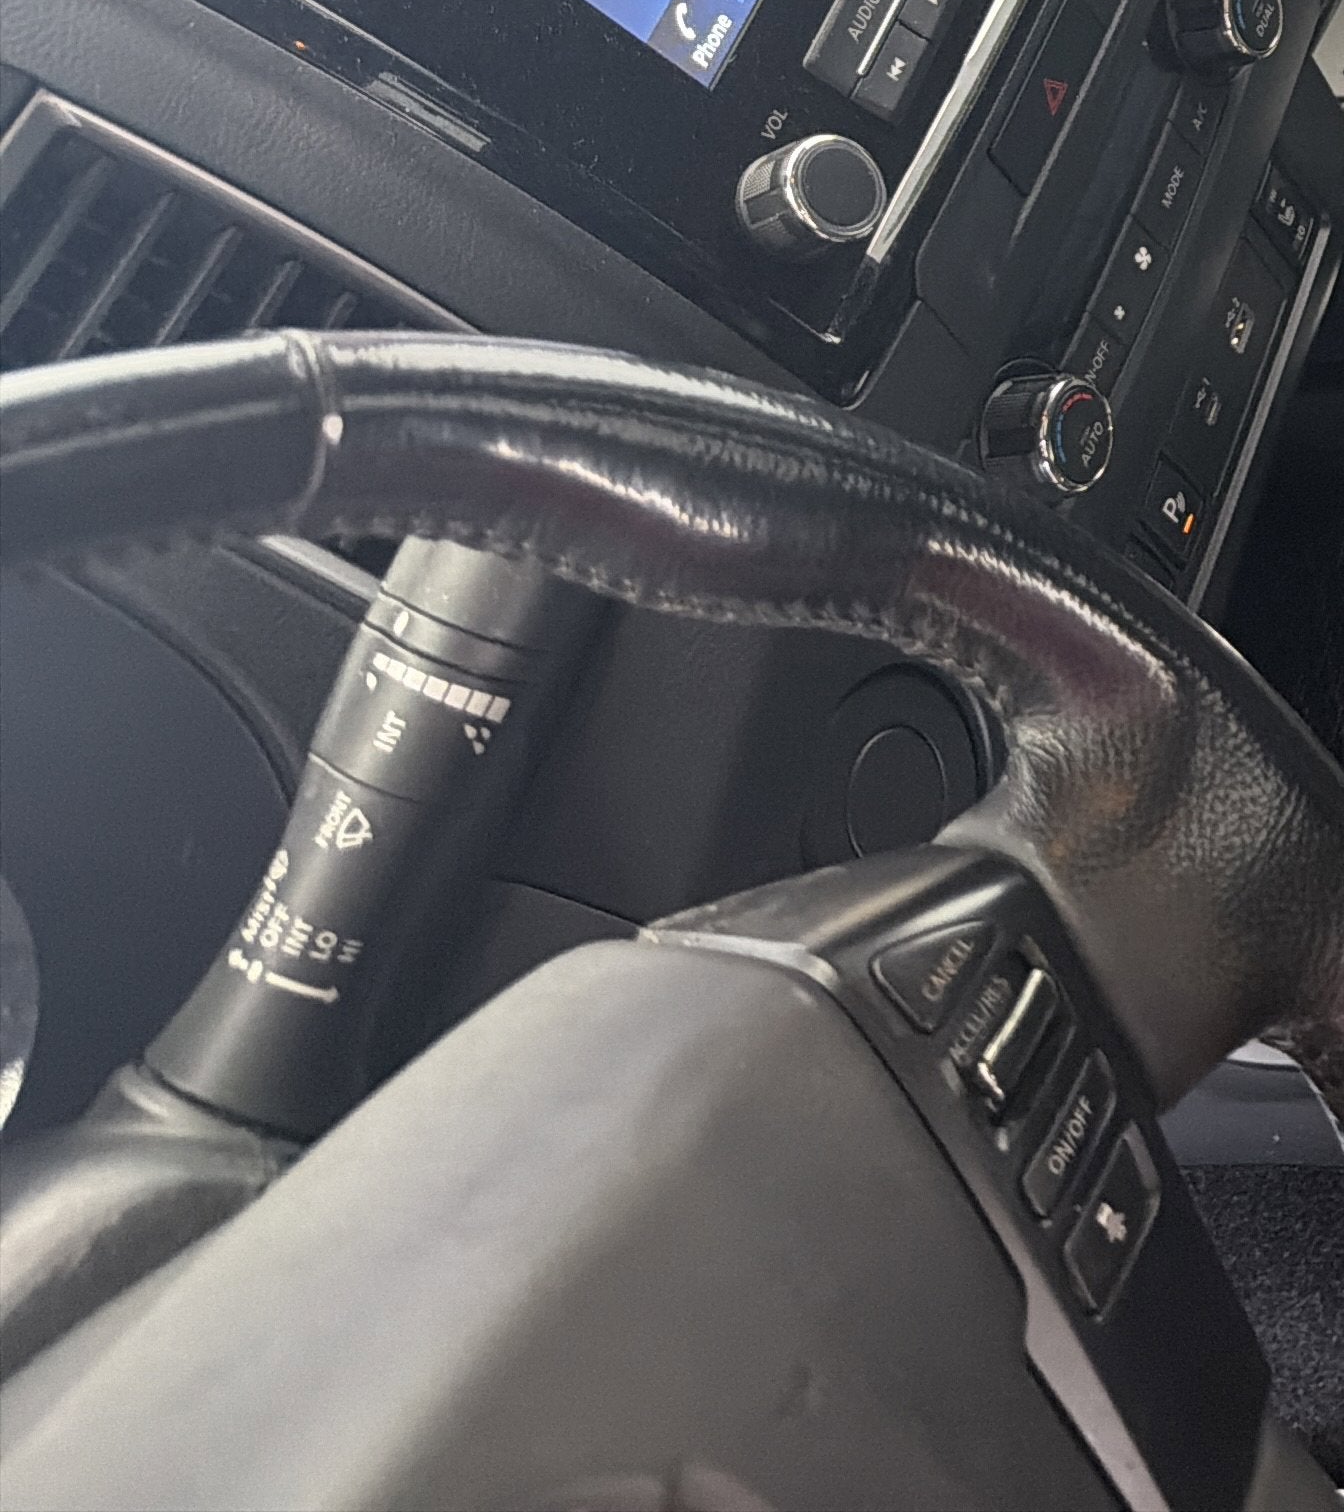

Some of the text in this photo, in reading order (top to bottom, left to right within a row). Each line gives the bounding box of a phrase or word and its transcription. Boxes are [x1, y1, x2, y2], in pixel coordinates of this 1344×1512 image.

[692, 13, 733, 68] Phone
[1255, 3, 1275, 38] DUAL
[761, 108, 788, 140] VOL
[1161, 165, 1184, 208] MODE
[1081, 421, 1104, 468] AUTO
[373, 710, 408, 753] INT
[314, 791, 352, 849] FRONT
[259, 901, 290, 948] OFF
[309, 930, 338, 961] LO
[1048, 1095, 1095, 1176] ON/OFF
